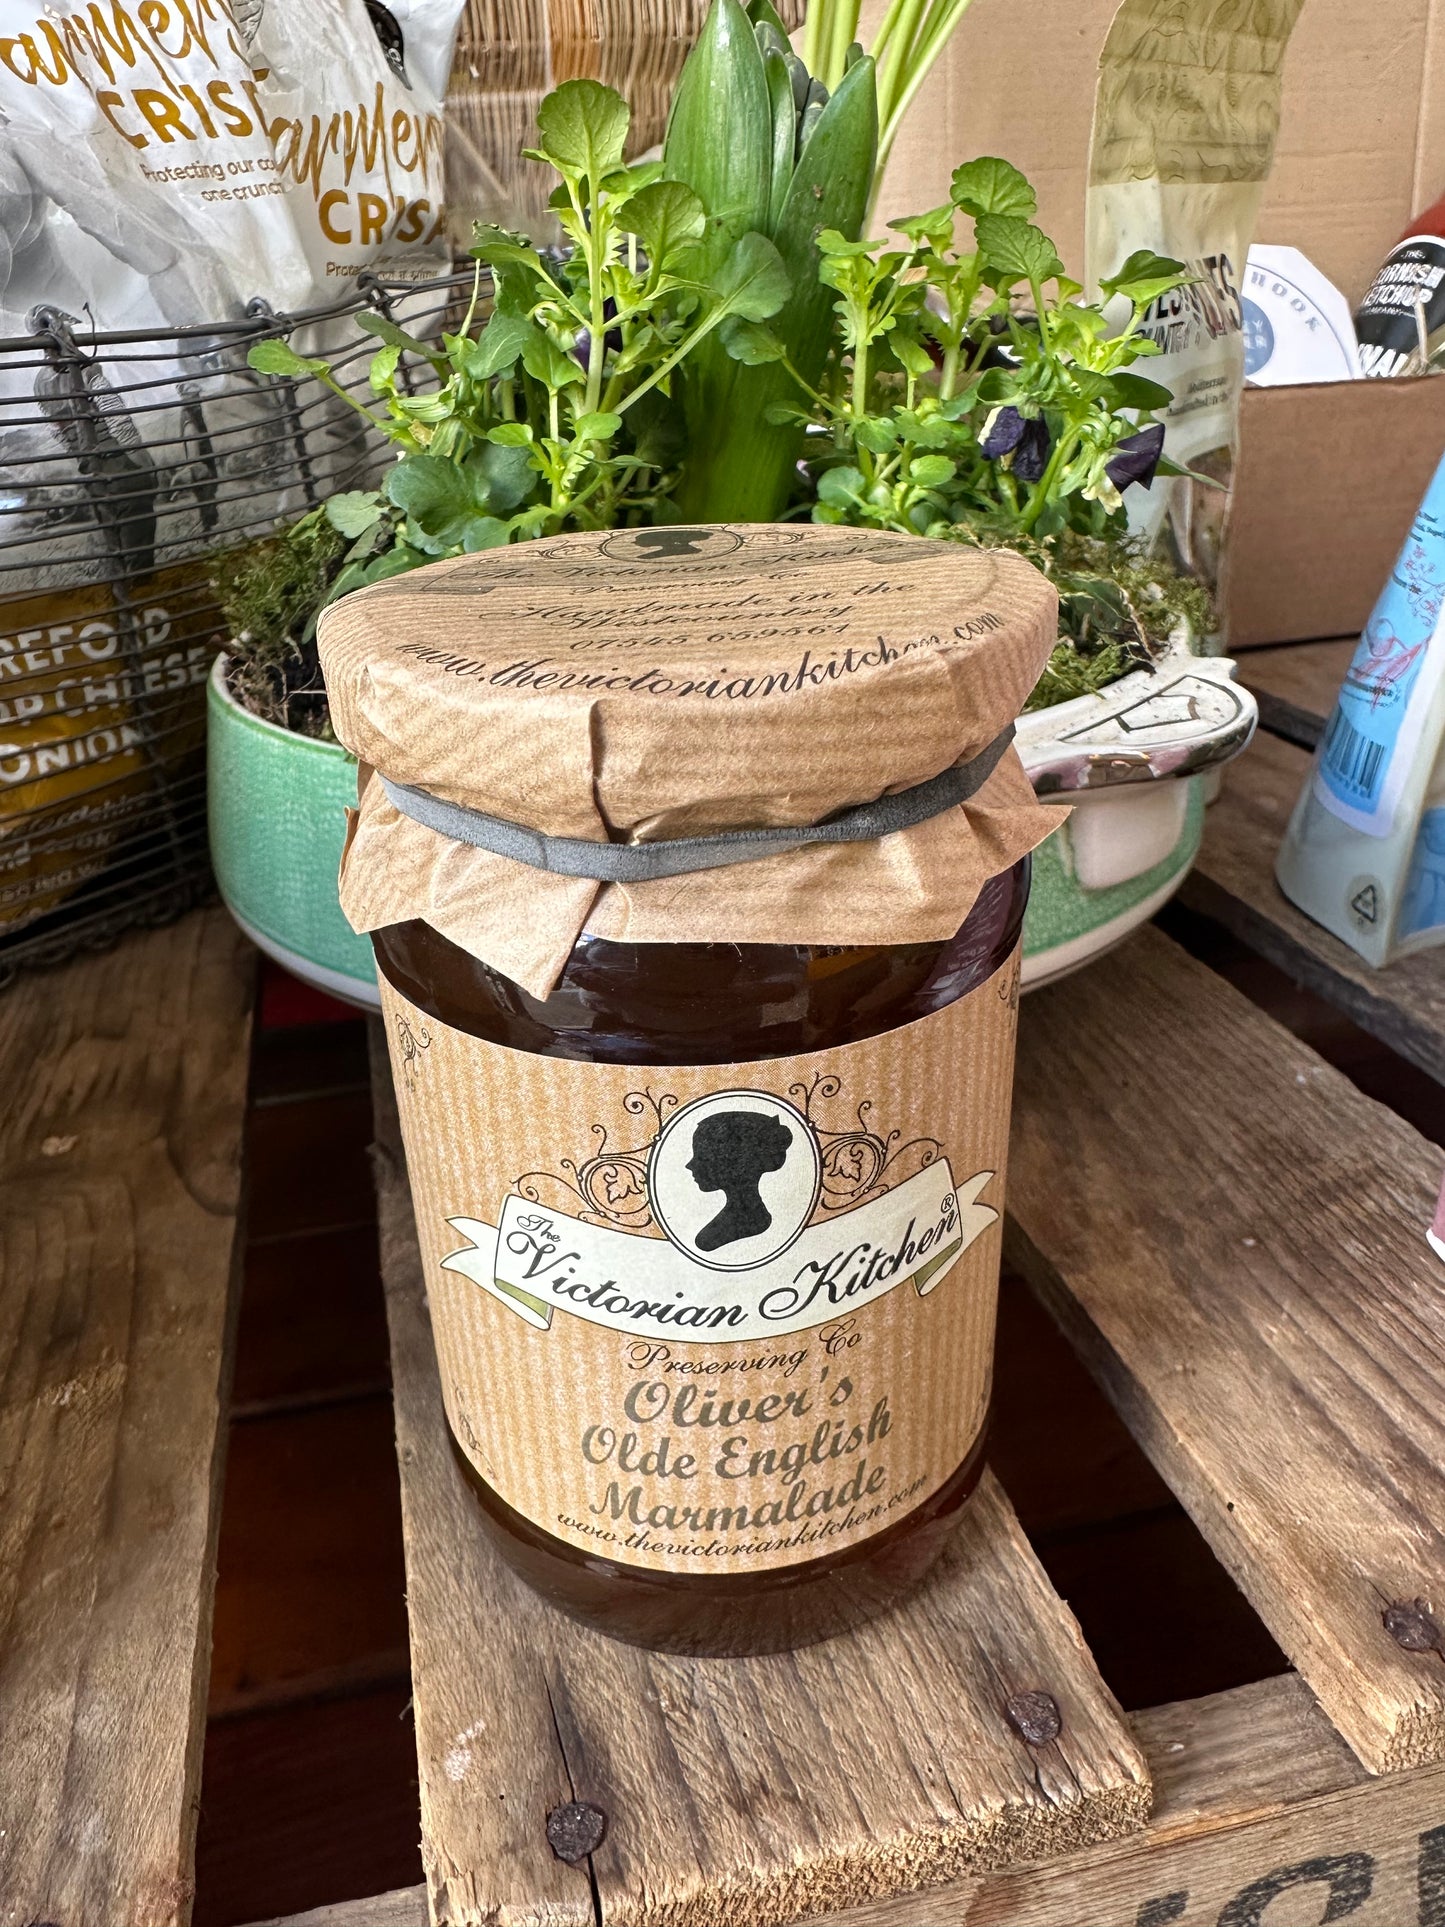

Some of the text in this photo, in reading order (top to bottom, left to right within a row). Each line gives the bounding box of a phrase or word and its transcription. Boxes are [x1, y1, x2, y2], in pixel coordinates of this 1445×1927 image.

[139, 160, 226, 182] Protecting
[227, 159, 255, 175] our
[201, 188, 232, 202] one
[1362, 284, 1434, 308] ETCHUP
[553, 564, 732, 578] Victorian
[479, 579, 915, 621] Handmade in the
[550, 604, 854, 631] Westcountry
[516, 1214, 561, 1243] The
[505, 1230, 750, 1330] Victorian
[627, 1318, 862, 1377] Preserving Co
[623, 1365, 854, 1428] Oliver's
[581, 1395, 894, 1486] Olde English
[556, 1474, 928, 1556] www.thevictoriankitchen.com
[588, 1458, 886, 1532] Marmalade
